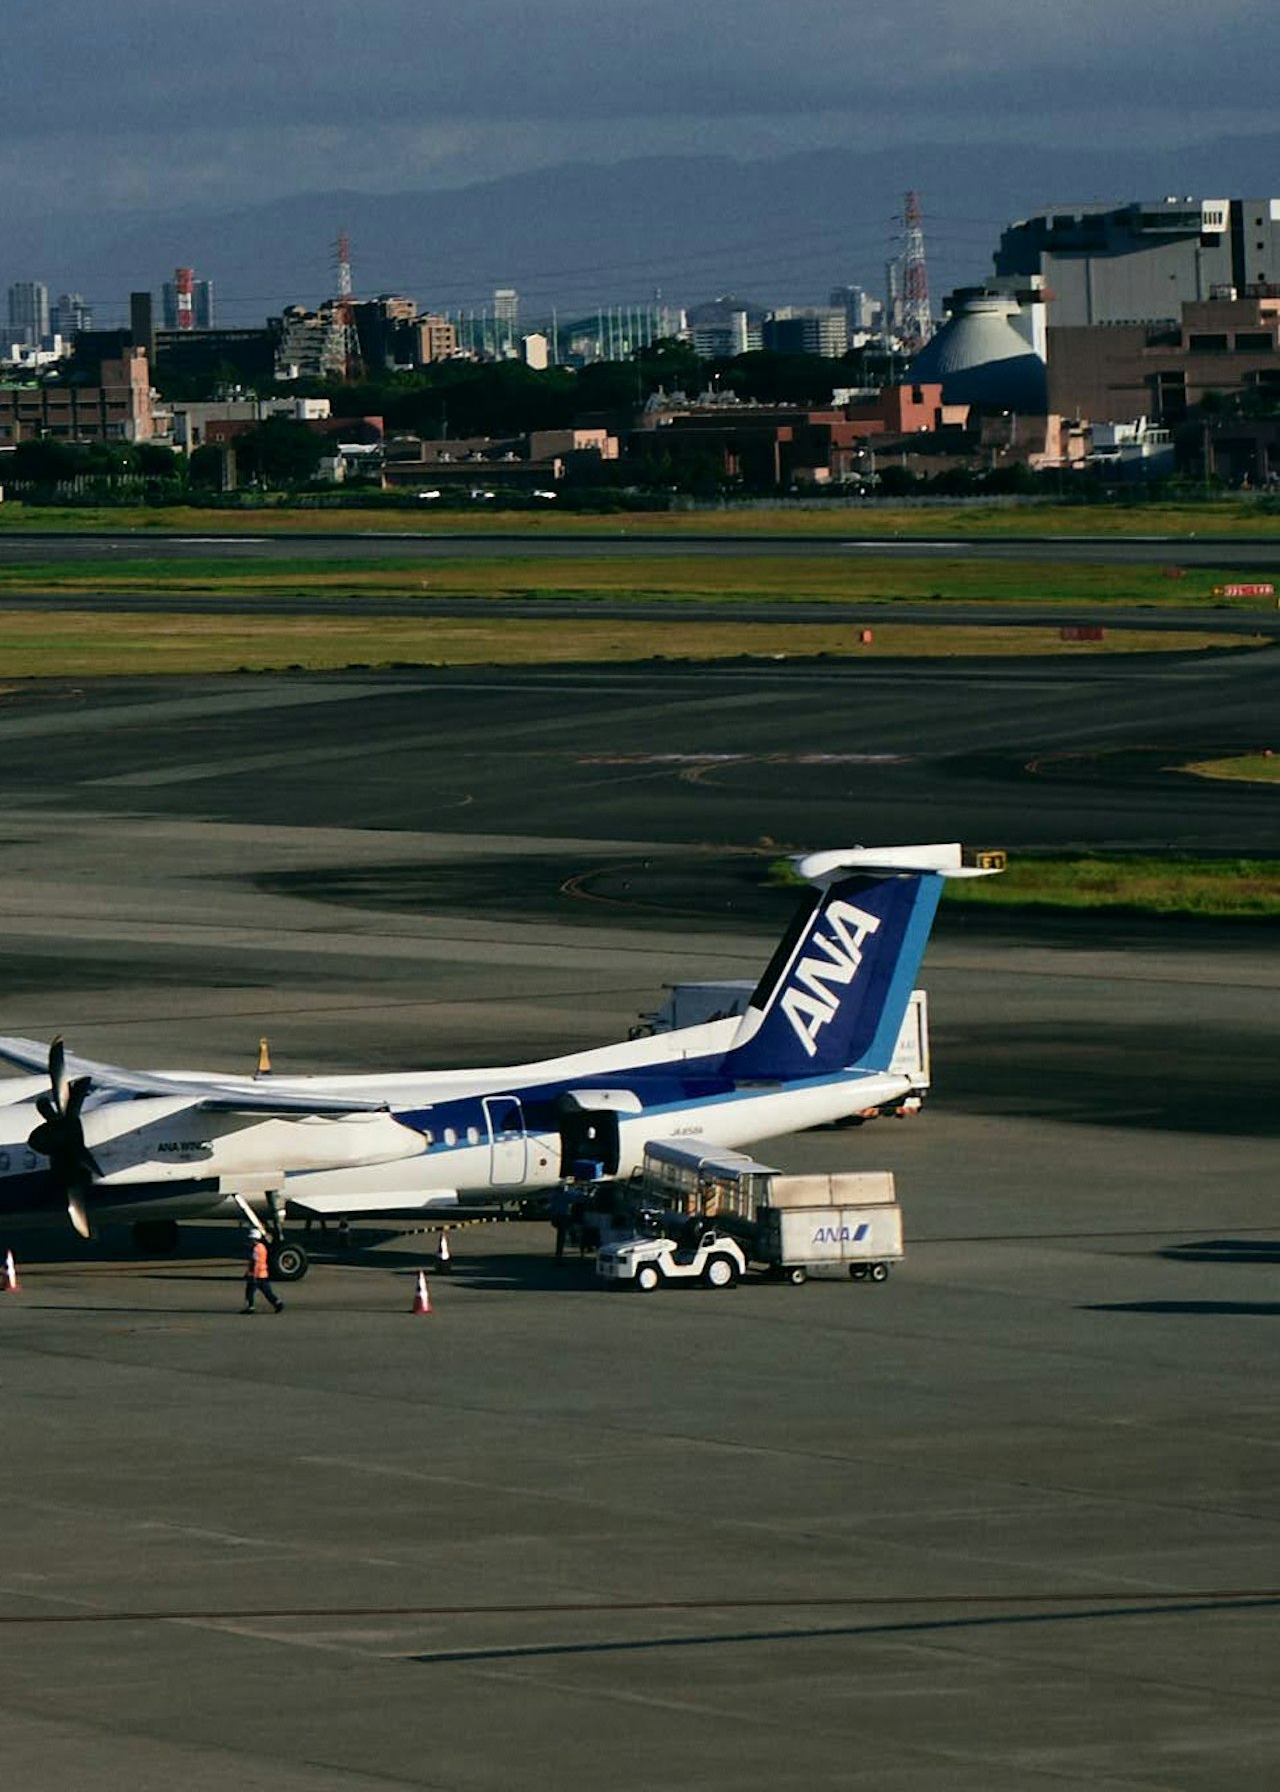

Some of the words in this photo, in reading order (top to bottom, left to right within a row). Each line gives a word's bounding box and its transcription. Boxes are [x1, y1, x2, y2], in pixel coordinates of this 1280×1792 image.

[780, 899, 881, 1056] ANA
[158, 1141, 179, 1152] ANA
[811, 1227, 849, 1243] ANA
